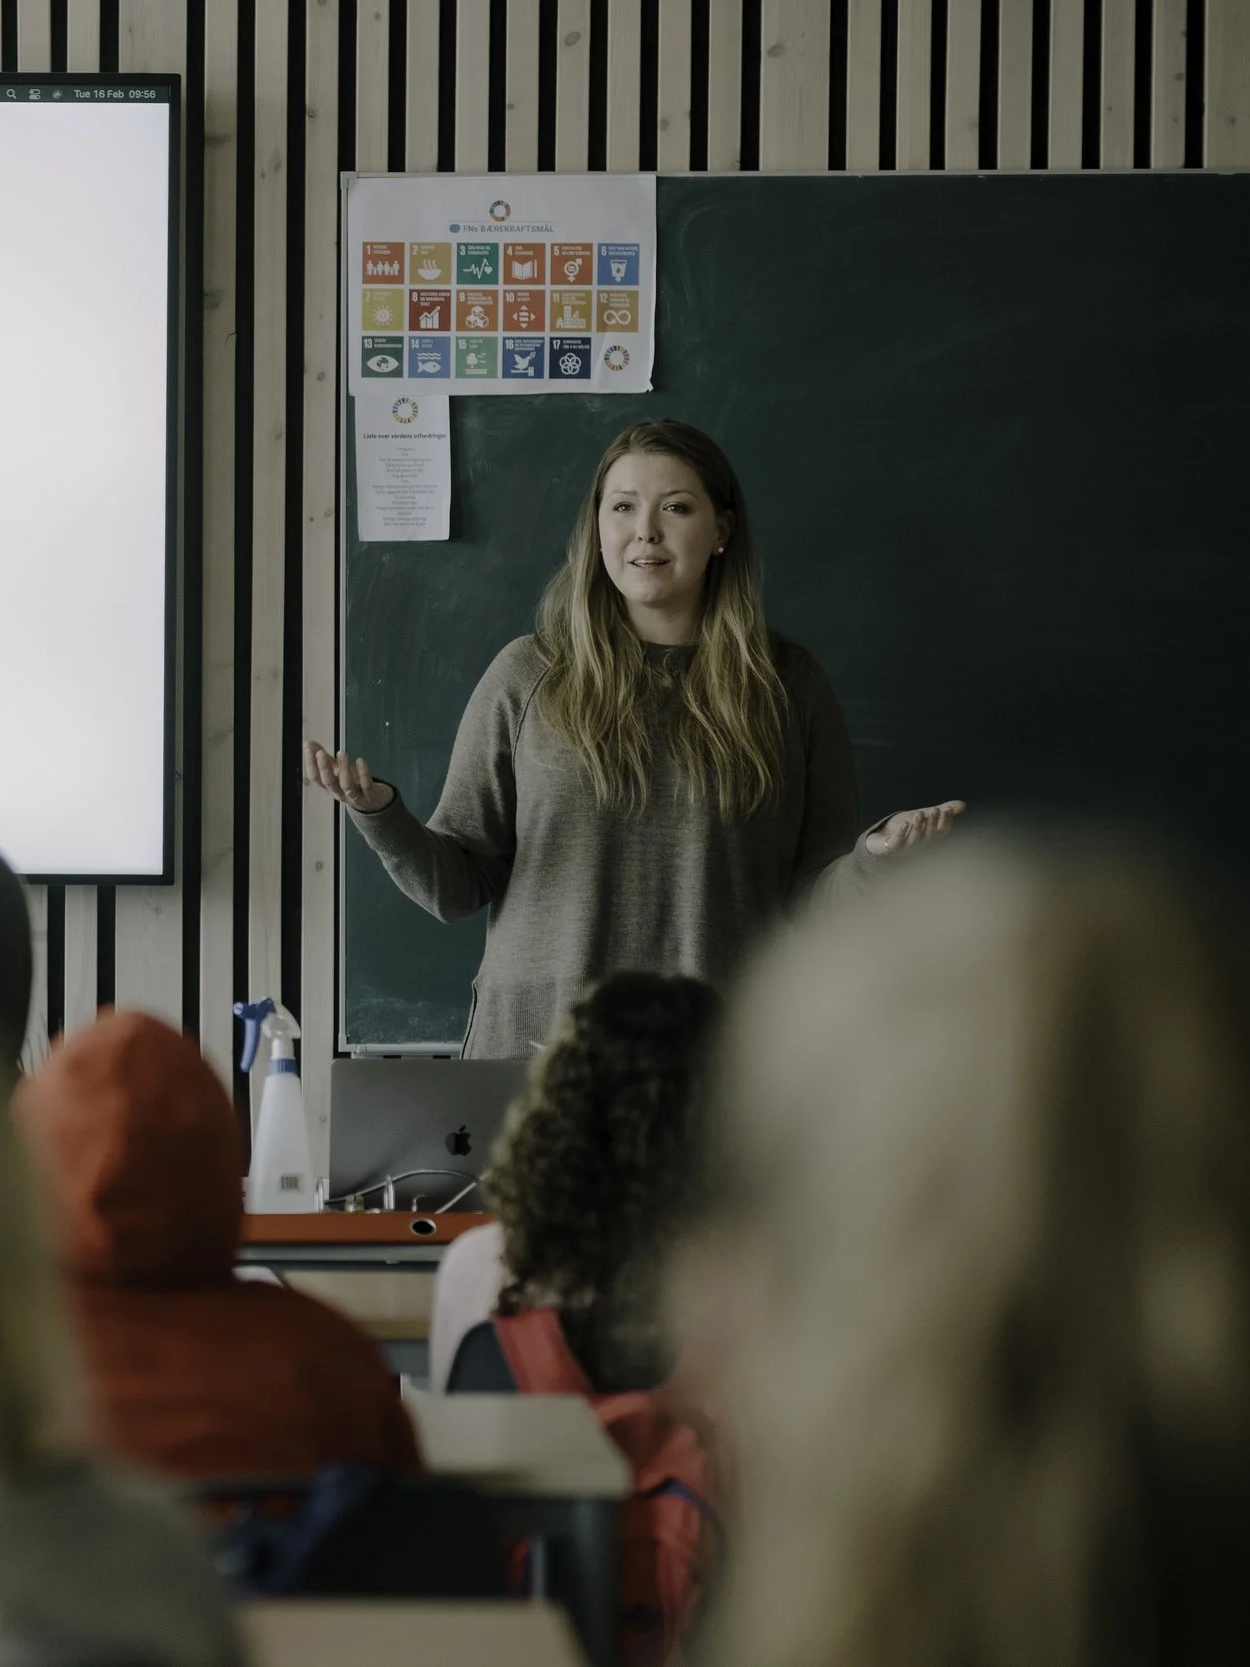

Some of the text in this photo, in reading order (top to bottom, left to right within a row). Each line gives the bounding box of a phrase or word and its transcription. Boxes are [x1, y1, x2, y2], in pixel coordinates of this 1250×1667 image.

[74, 89, 156, 98] Tue 16 Feb 09:56
[366, 245, 371, 255] 1
[412, 245, 419, 256] 2
[459, 245, 466, 256] 3
[506, 246, 513, 256] 4
[554, 245, 560, 256] 5
[601, 246, 608, 256] 6
[412, 292, 418, 302] 8
[459, 292, 466, 302] 9
[505, 292, 515, 303] 10
[552, 292, 560, 303] 11
[363, 338, 373, 349] 13
[411, 338, 420, 349] 14
[505, 339, 514, 349] 16
[552, 339, 561, 350] 17
